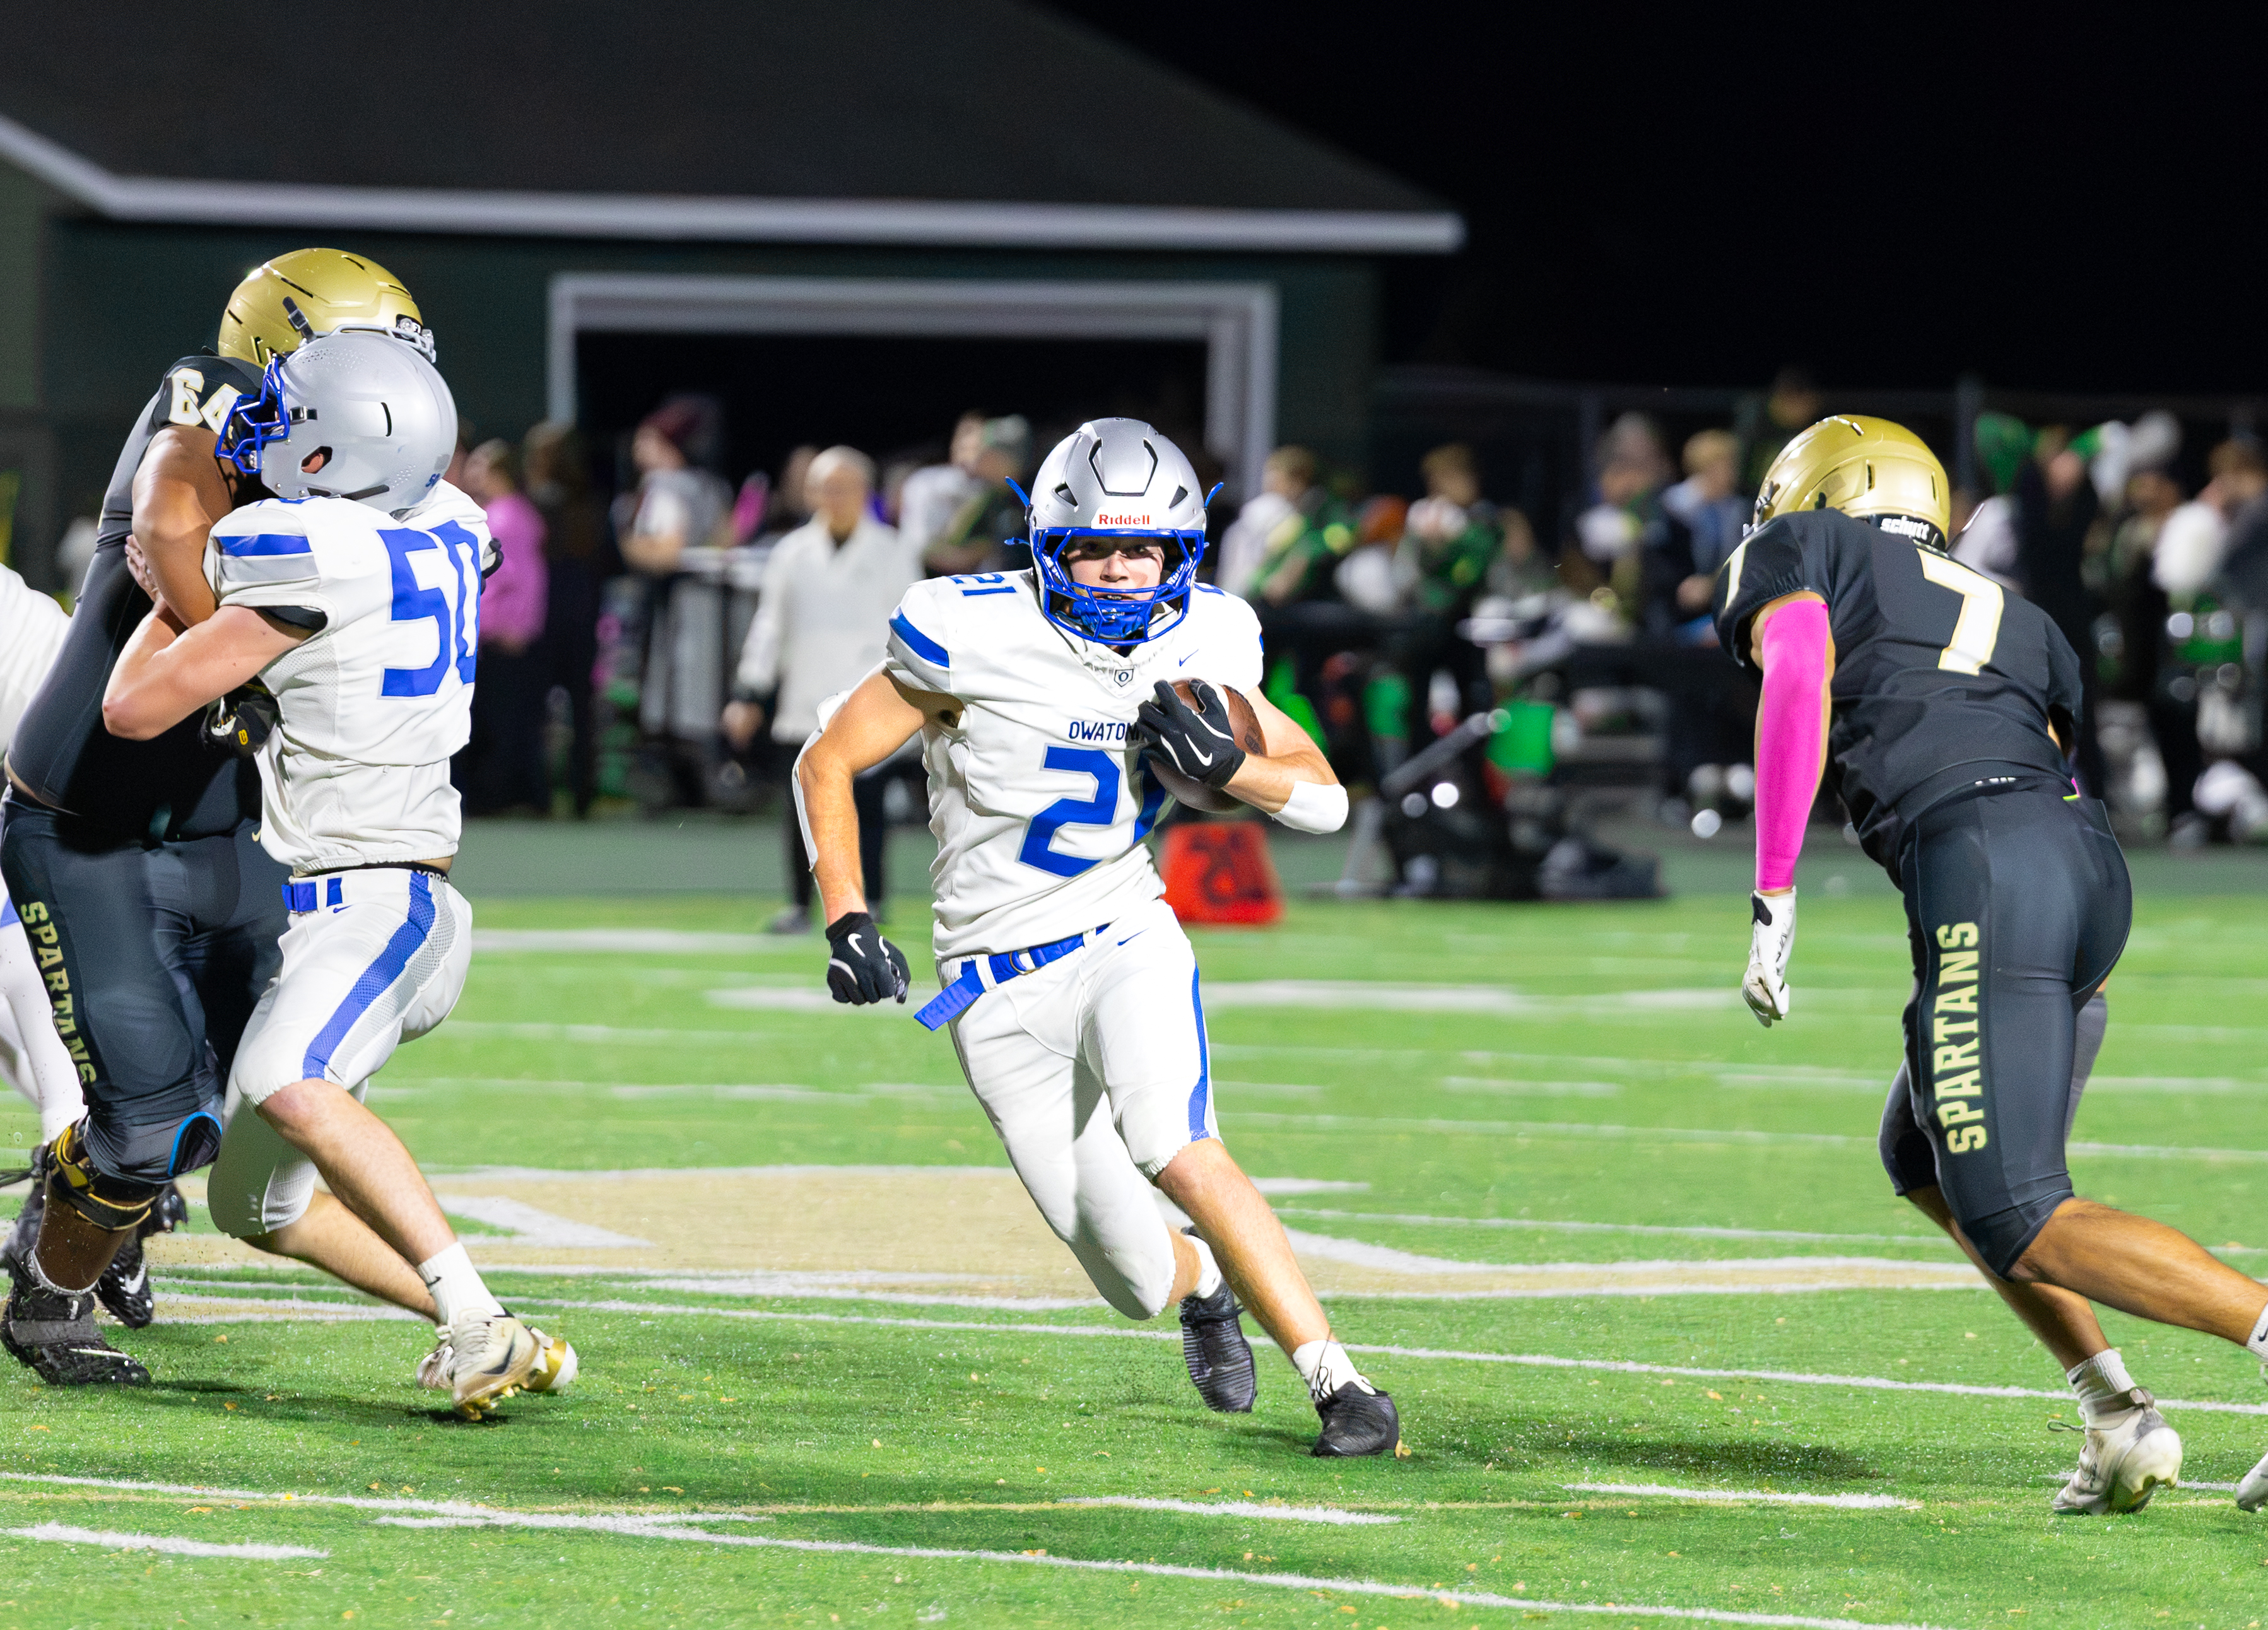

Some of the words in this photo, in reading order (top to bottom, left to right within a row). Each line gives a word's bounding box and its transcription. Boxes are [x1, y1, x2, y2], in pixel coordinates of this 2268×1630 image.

[168, 368, 244, 440] 64
[1099, 514, 1149, 524] Riddell
[1880, 515, 1930, 541] schutt
[375, 520, 481, 698] 50
[948, 572, 1016, 596] 21
[1916, 548, 2004, 676] 7
[1069, 720, 1139, 741] OWATON
[20, 901, 97, 1084] SPARTANS
[1934, 922, 1987, 1154] SPARTANS
